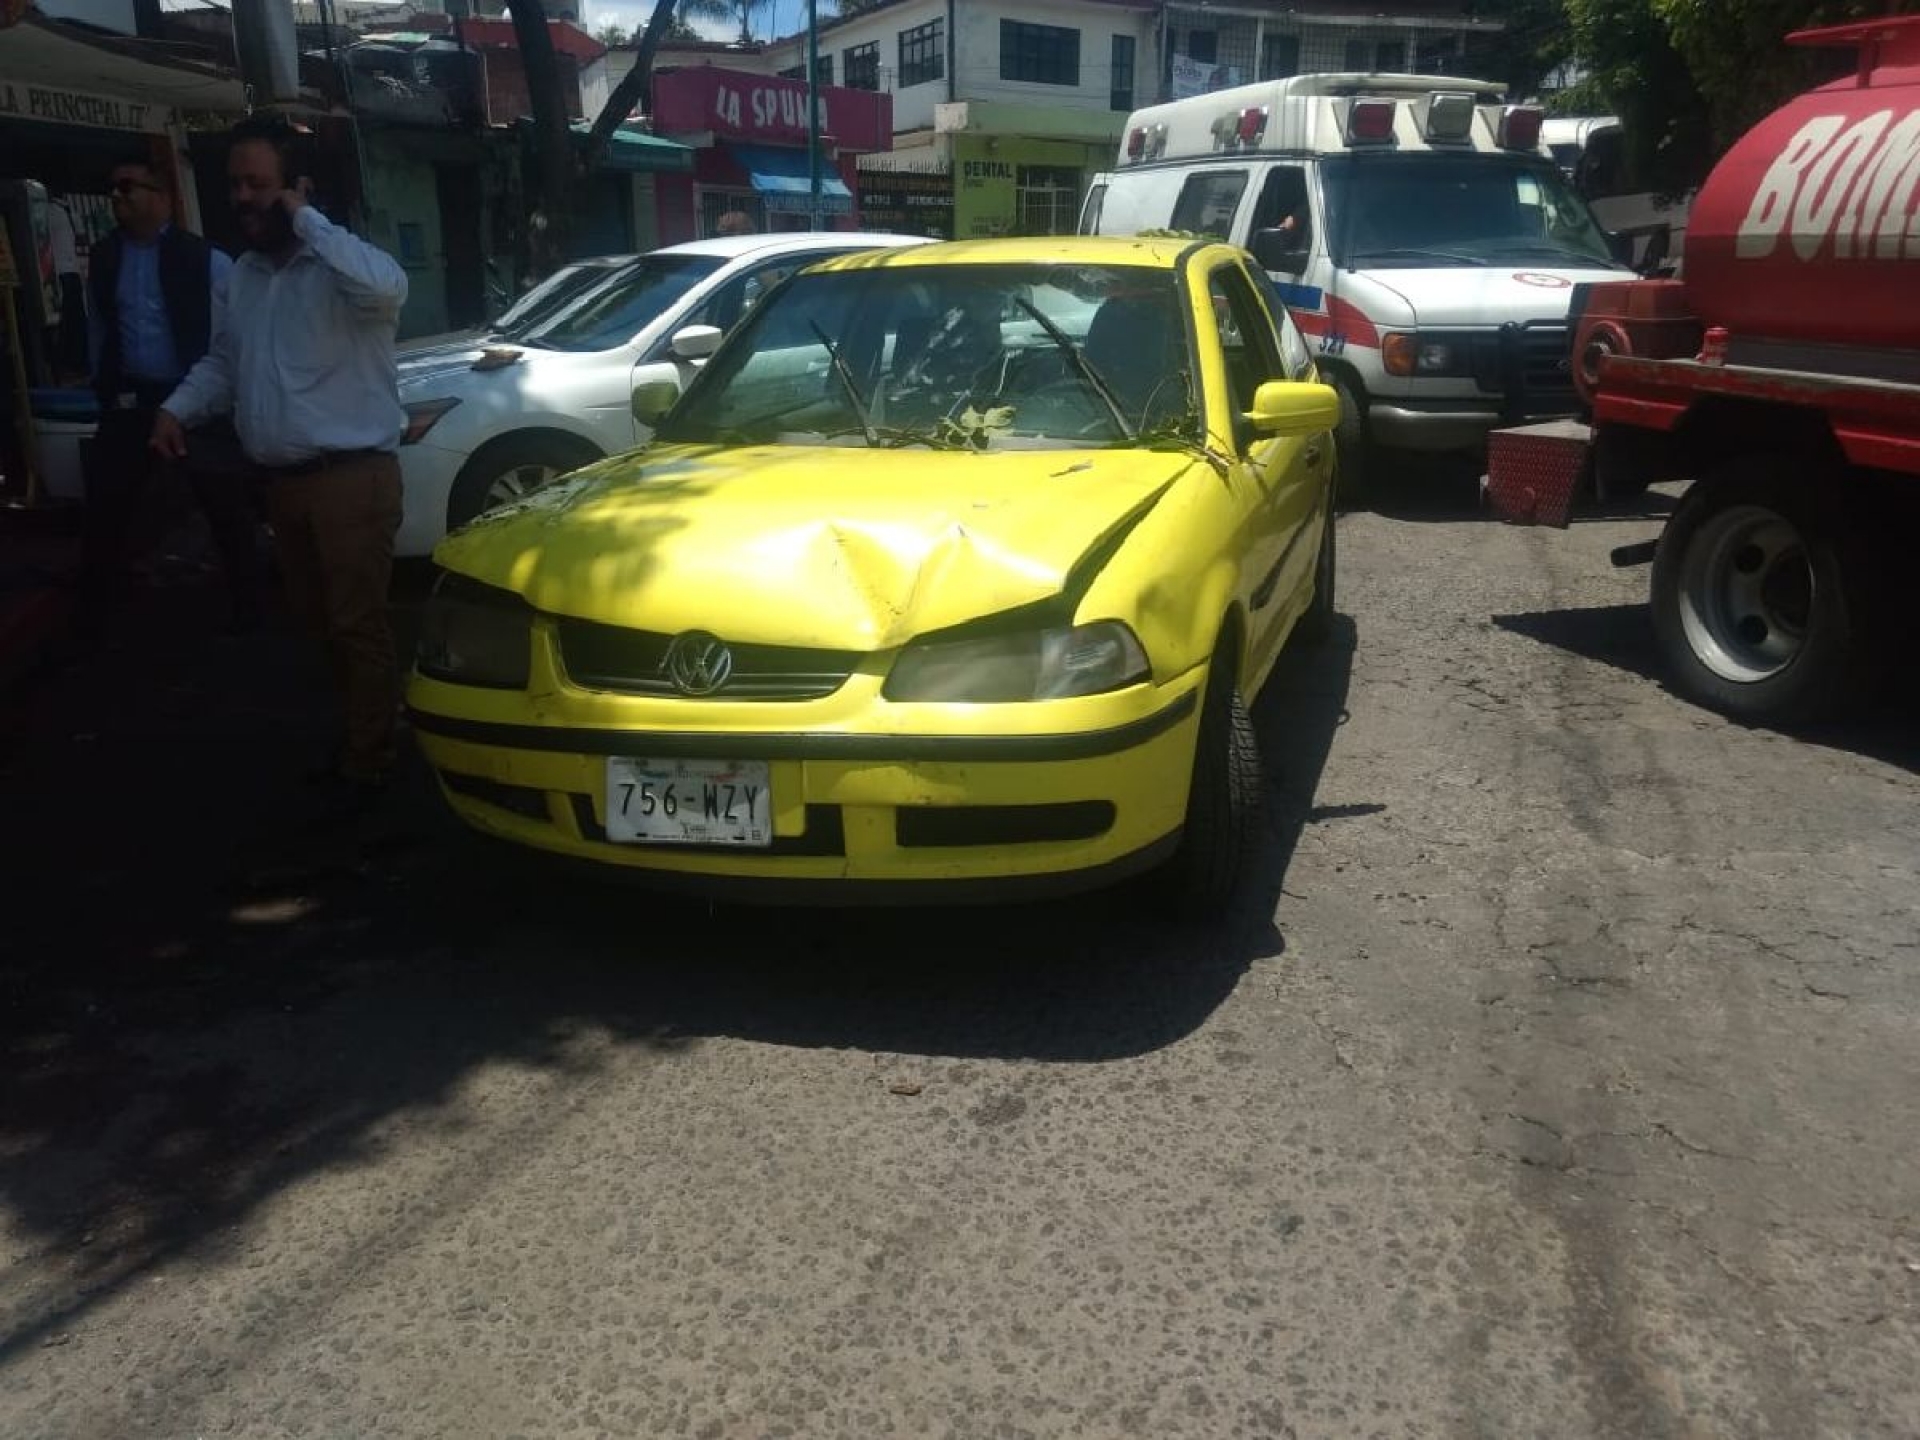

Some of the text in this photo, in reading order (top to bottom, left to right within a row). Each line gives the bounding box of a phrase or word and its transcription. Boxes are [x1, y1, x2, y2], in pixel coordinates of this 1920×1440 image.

[716, 85, 741, 128] LA
[964, 161, 1012, 178] DENTAL
[1736, 109, 1920, 262] BOM
[617, 782, 758, 823] 756-WZY
